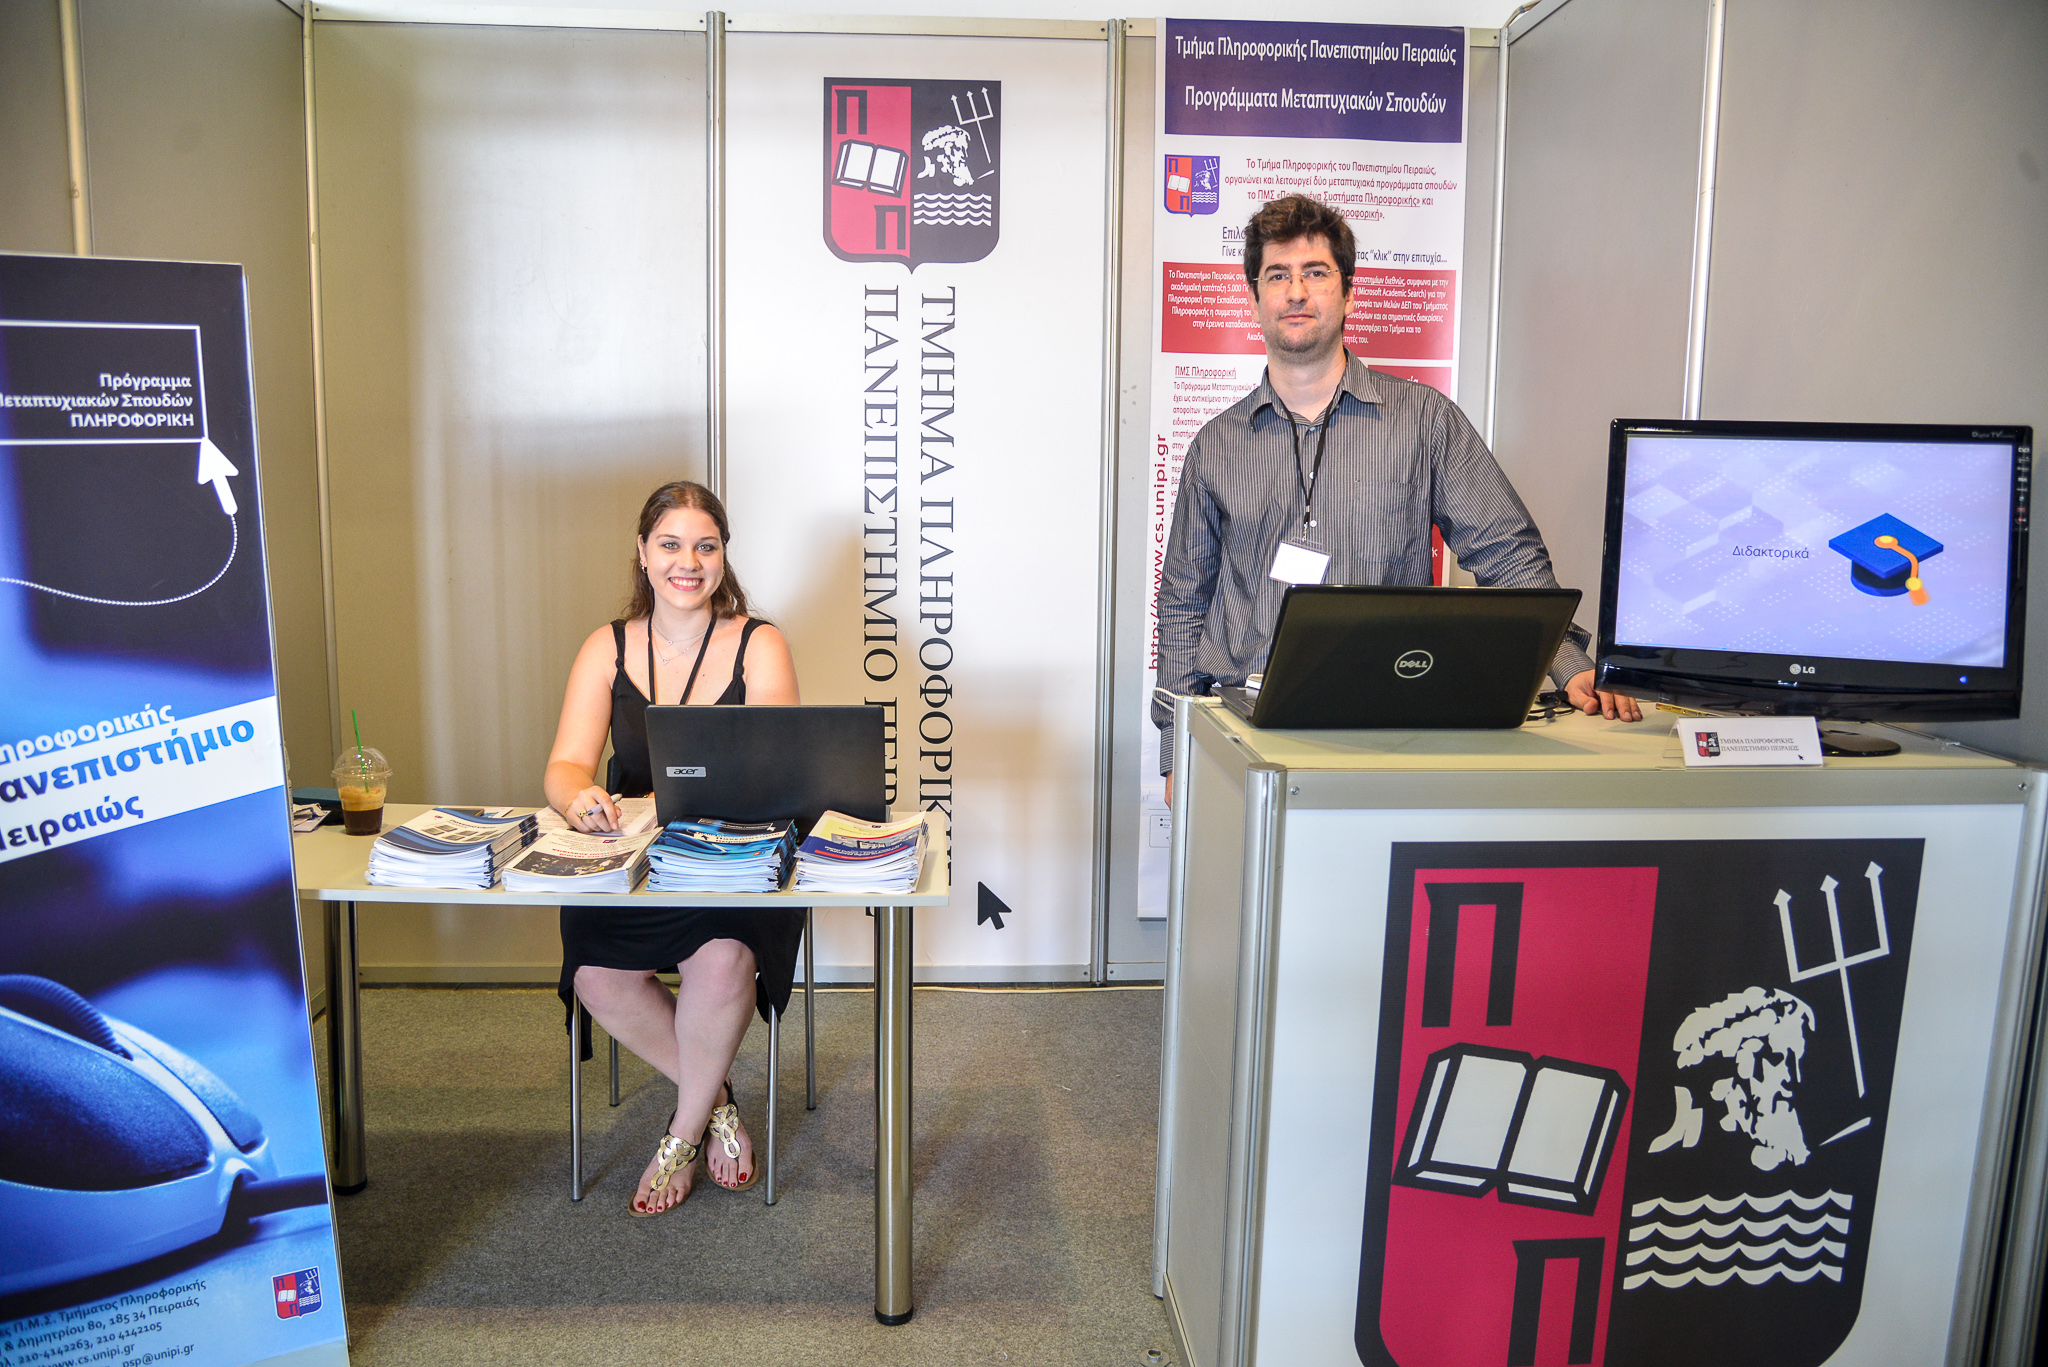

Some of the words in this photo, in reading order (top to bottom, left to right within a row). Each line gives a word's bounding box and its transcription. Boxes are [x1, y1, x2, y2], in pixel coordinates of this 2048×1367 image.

[1175, 36, 1214, 59] Τμήμα
[1218, 37, 1307, 61] Πληροφορικής
[1310, 40, 1399, 64] Πανεπιστημίου
[1402, 43, 1457, 66] Πειραιώς
[1185, 85, 1278, 110] Προγράμματα
[1281, 88, 1383, 115] Μεταπτυχιακών
[1386, 91, 1447, 114] Σπουδών
[1246, 158, 1256, 169] Το
[1257, 159, 1281, 172] Τμήμα
[1282, 159, 1337, 173] Πληροφορικής
[1338, 163, 1351, 171] του
[1352, 161, 1402, 175] Πανεπιστημίου
[1403, 164, 1437, 176] Πειραιώς,
[1224, 174, 1262, 187] οργανώνει
[1263, 176, 1275, 185] και
[1275, 174, 1312, 188] λειτουργεί
[1313, 175, 1327, 186] δύο
[1328, 176, 1375, 189] μεταπτυχιακά
[1376, 179, 1423, 192] προγράμματα
[1424, 179, 1457, 191] σπουδών
[1247, 191, 1256, 200] το
[1258, 189, 1275, 200] ΠΜΣ
[1323, 191, 1363, 204] Συστήματα
[1364, 192, 1420, 207] Πληροφορικής»
[1421, 197, 1434, 206] και
[1221, 245, 1236, 257] Γίνε
[1392, 252, 1410, 265] στην
[100, 372, 192, 390] Πρόγραμμα
[1174, 365, 1190, 377] ΠΜΣ
[1191, 366, 1237, 379] Πληροφορική
[920, 285, 956, 486] ΤΜΗΜΑ
[1180, 381, 1211, 392] Πρόγραμμα
[1211, 382, 1252, 392] Μεταπτυχιακών
[121, 392, 193, 408] Σπουδών
[71, 412, 195, 427] ΠΛΗΡΟΦΟΡΙΚΗ
[863, 284, 899, 682] ΠΑΝΕΠΙΣΤΗΜΙΟ
[1732, 544, 1809, 561] Διδακτορικά
[1398, 659, 1428, 669] DELL
[1802, 665, 1816, 674] LG
[0, 719, 255, 803] ανεπιστήμιο
[673, 767, 699, 776] acer
[59, 1301, 118, 1323] Τμήματος
[120, 1279, 206, 1307] Πληροφορικής
[18, 1326, 84, 1348] Δημητρίου
[110, 1313, 130, 1325] 185
[132, 1311, 147, 1322] 34
[148, 1296, 200, 1315] Πειραιάς
[96, 1333, 116, 1345] 210
[118, 1322, 162, 1340] 4142105
